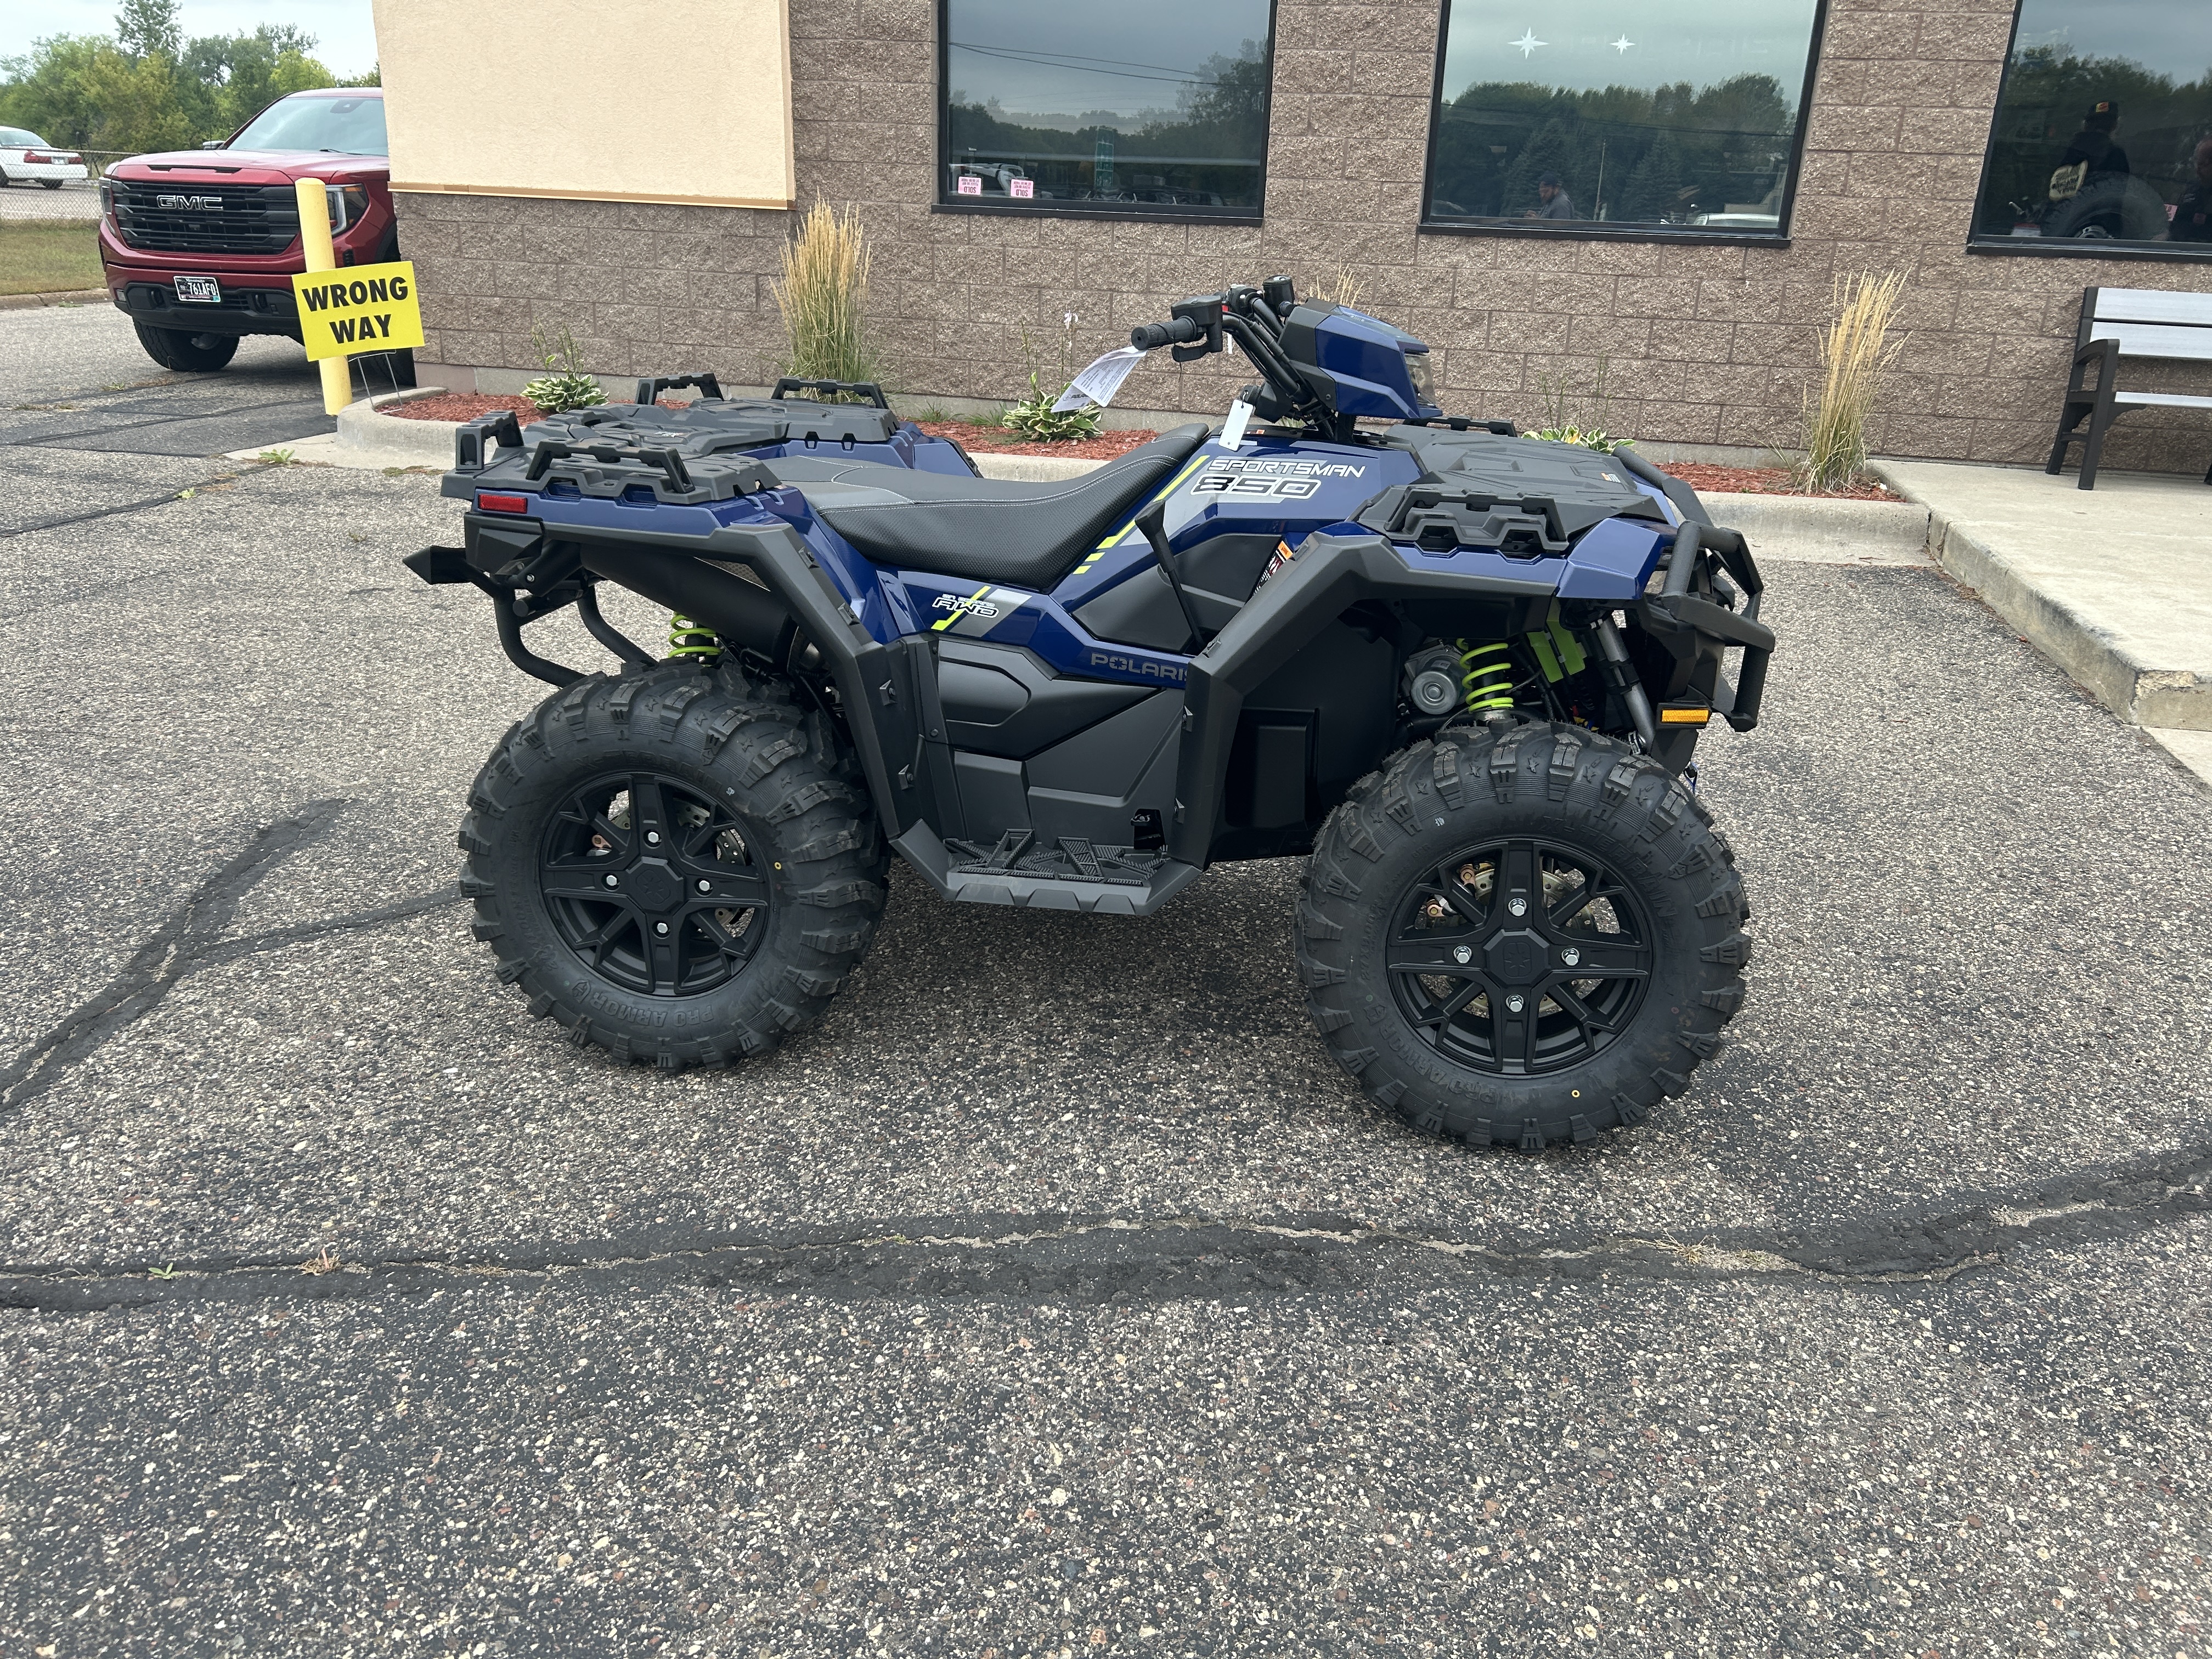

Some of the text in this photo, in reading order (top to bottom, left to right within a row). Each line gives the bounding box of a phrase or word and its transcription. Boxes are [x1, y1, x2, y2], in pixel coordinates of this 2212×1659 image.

[157, 195, 223, 211] GMC
[302, 276, 408, 312] WRONG
[329, 314, 391, 344] WAY
[1208, 459, 1365, 478] SPORTSMAN
[1190, 473, 1321, 499] 850
[932, 597, 999, 618] AWD
[1091, 653, 1187, 681] POLARI
[589, 992, 714, 1028] PRO ARMOR
[1379, 1022, 1496, 1104] PRO ARMOR
